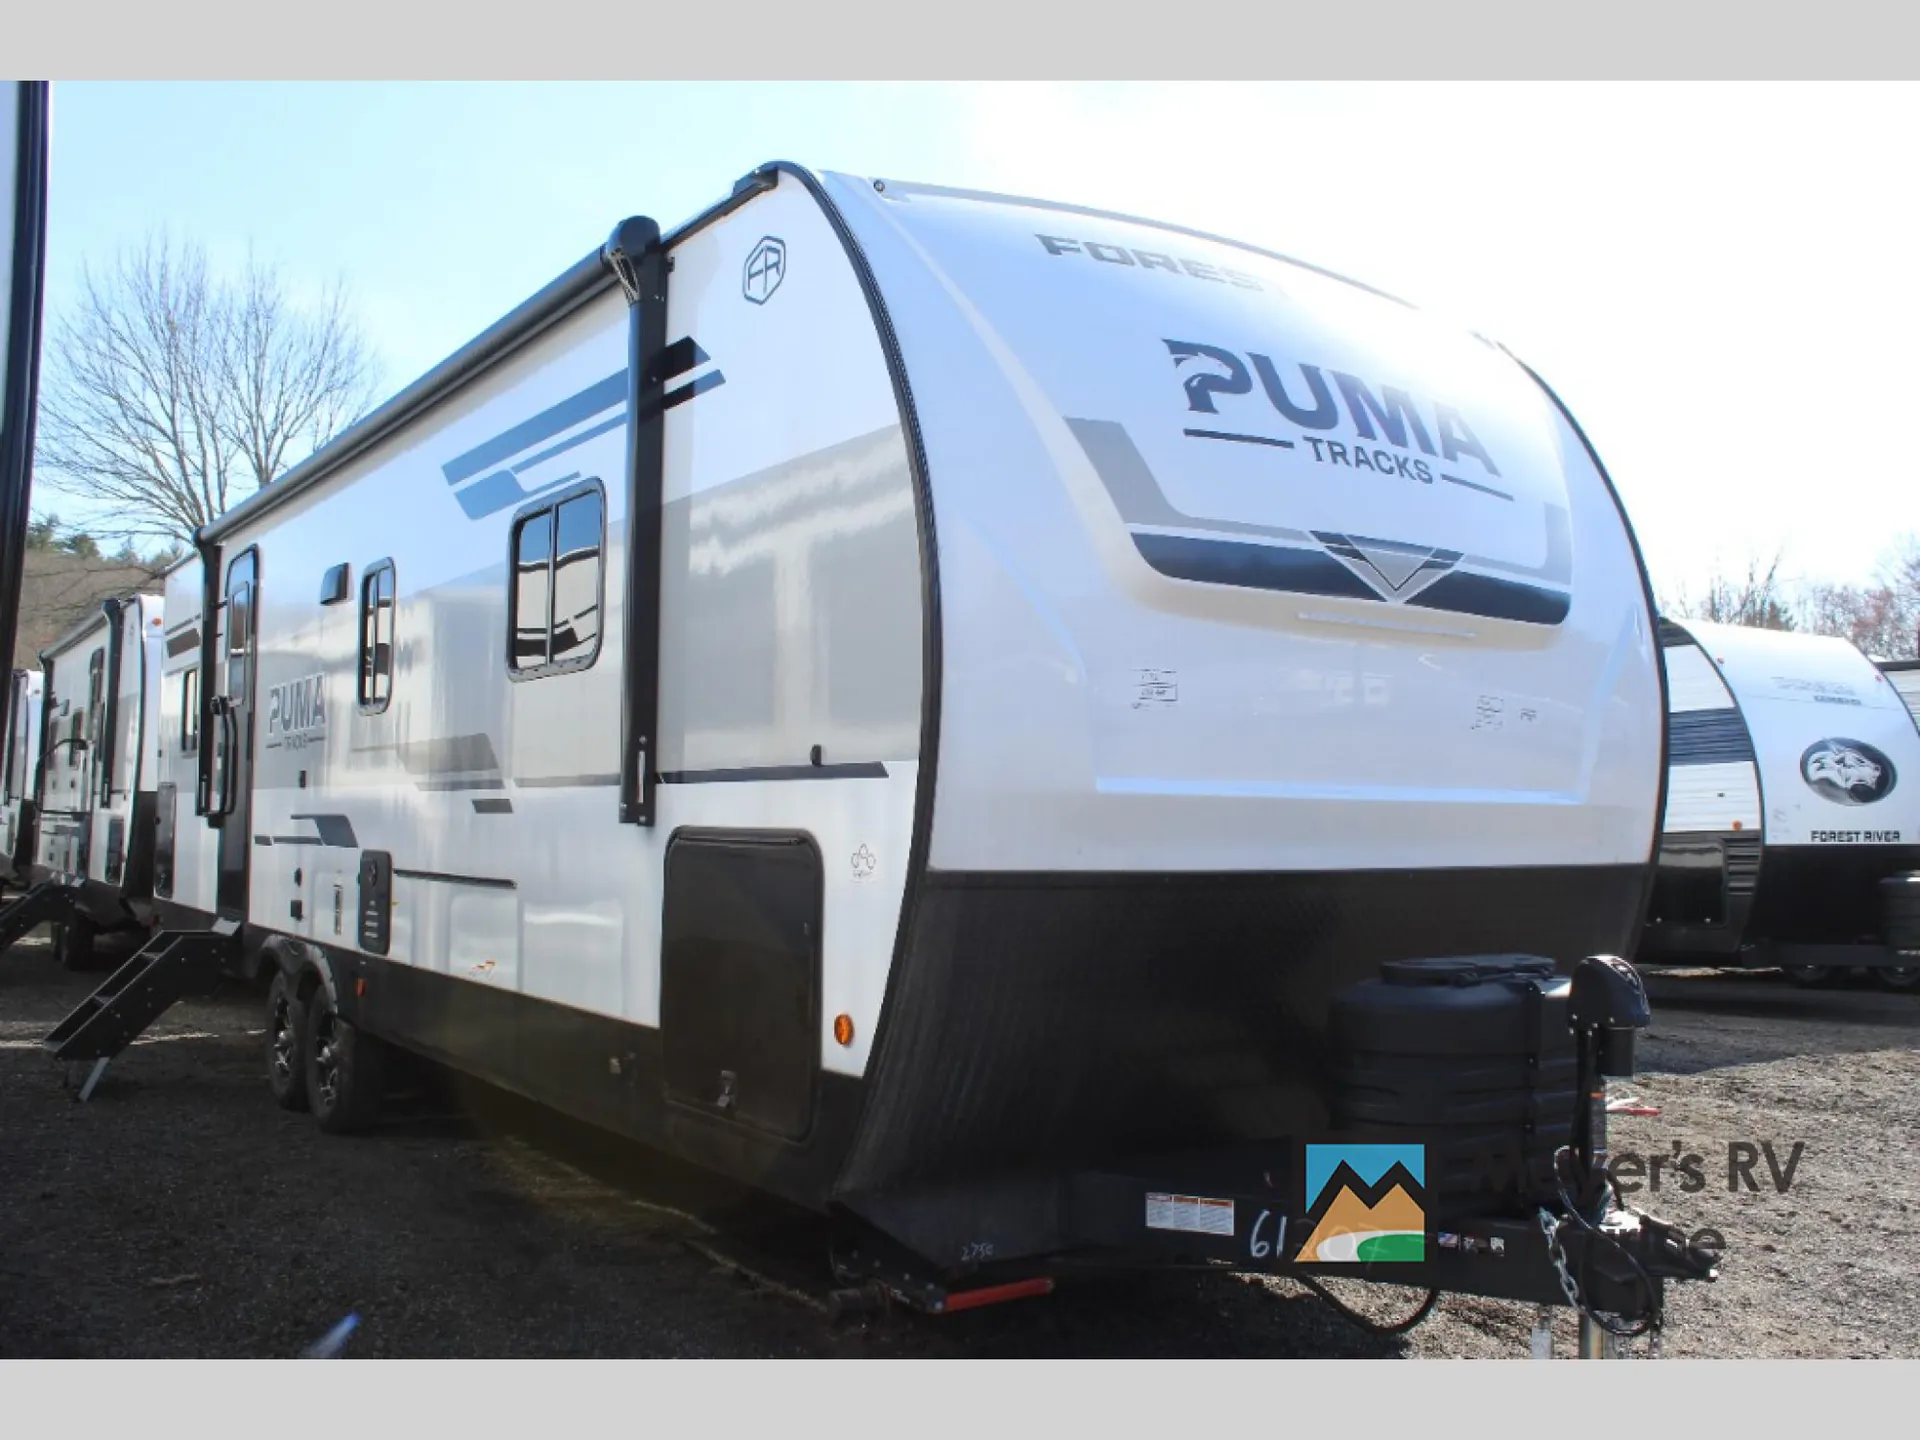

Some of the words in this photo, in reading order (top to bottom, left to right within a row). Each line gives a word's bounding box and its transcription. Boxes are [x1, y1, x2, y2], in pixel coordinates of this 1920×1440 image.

[1035, 233, 1284, 294] FORES
[1162, 338, 1502, 478] PUMA
[1302, 435, 1433, 484] TRACKS
[268, 674, 326, 734] PUMA
[1811, 830, 1861, 842] FOREST
[1864, 830, 1900, 842] RIVER
